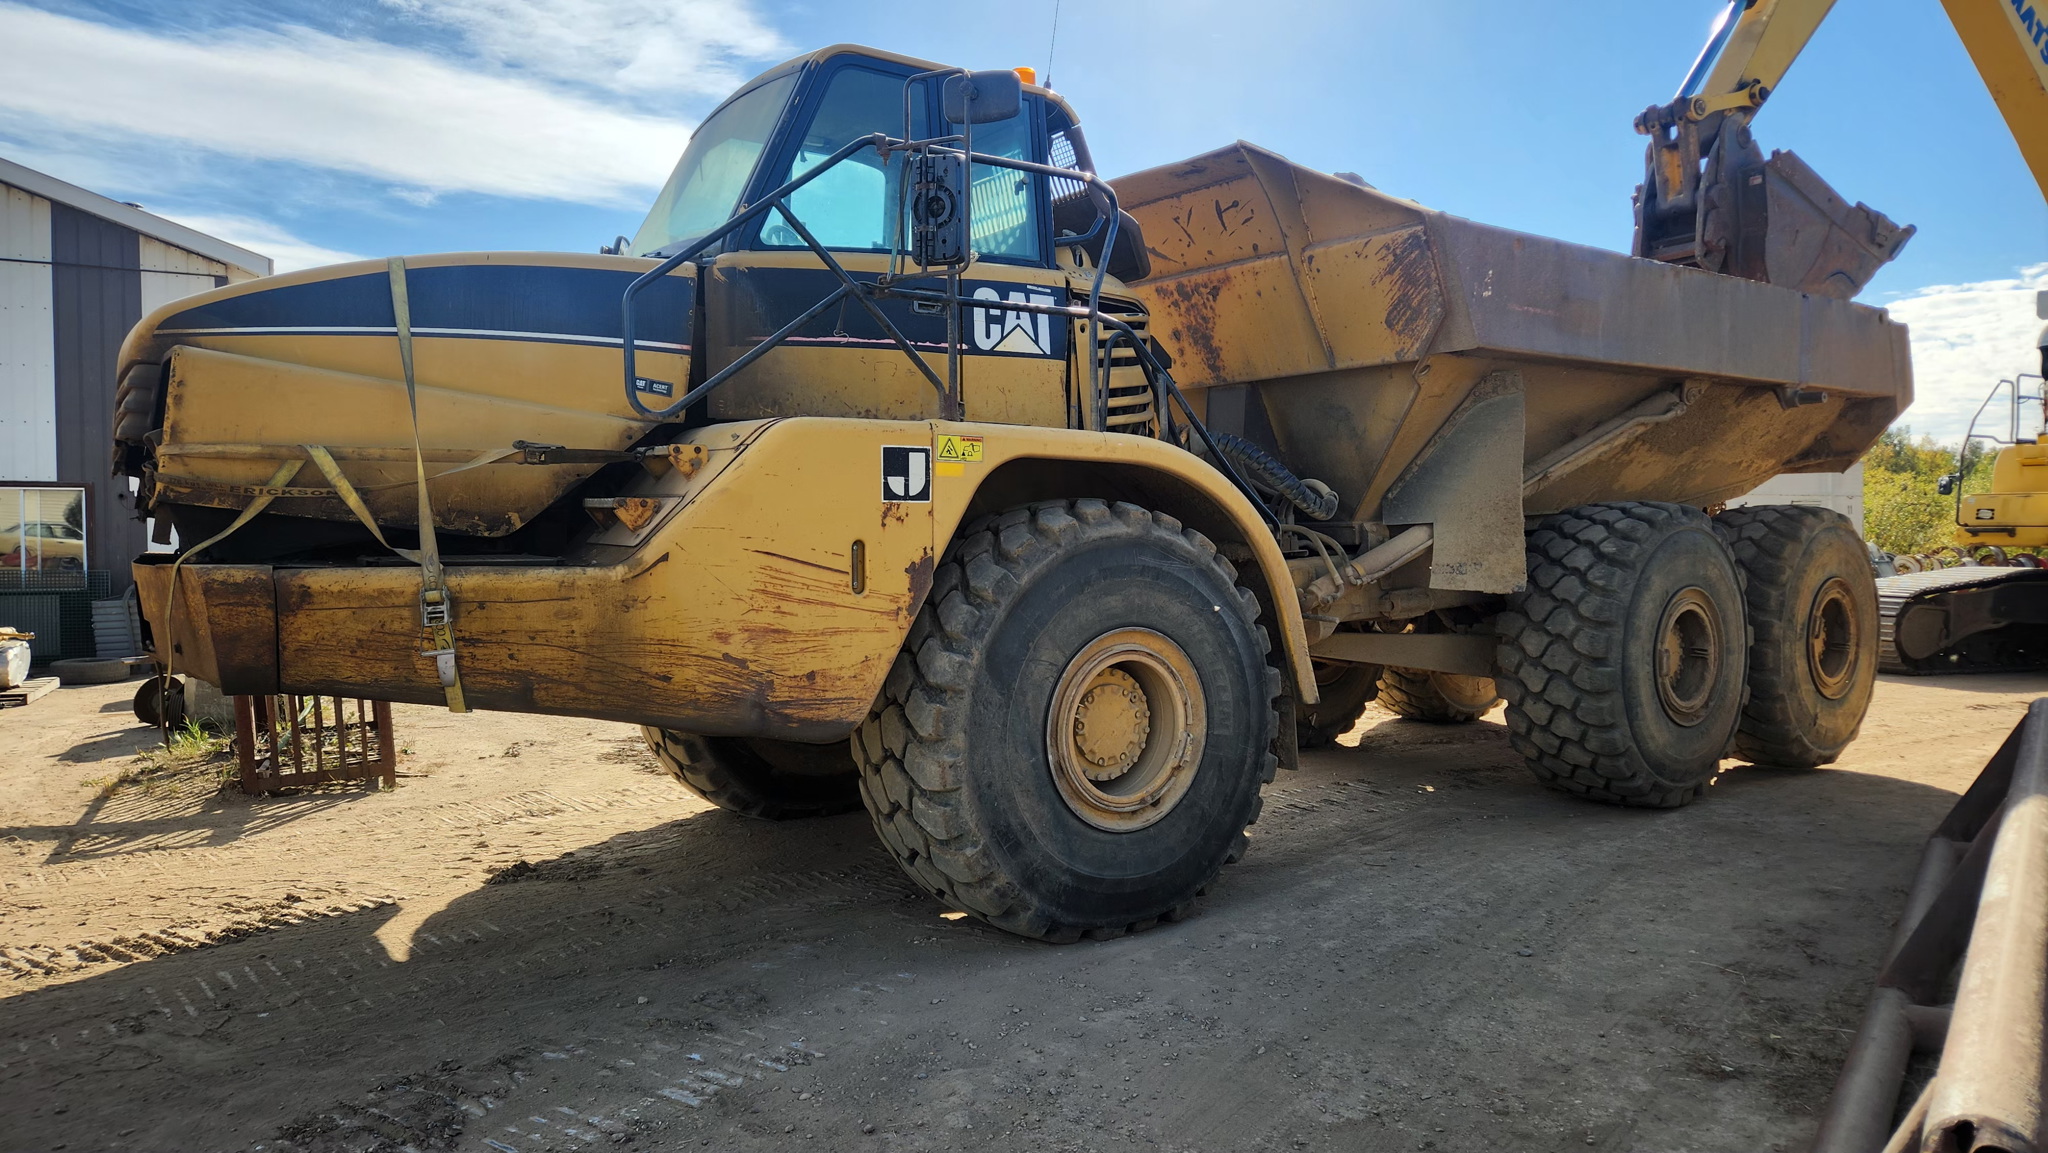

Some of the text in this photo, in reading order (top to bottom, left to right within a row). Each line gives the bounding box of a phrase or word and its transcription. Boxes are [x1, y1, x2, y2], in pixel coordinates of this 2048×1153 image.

[973, 287, 1054, 355] CAT
[636, 379, 646, 387] CAT
[229, 485, 338, 496] ERICKSON
